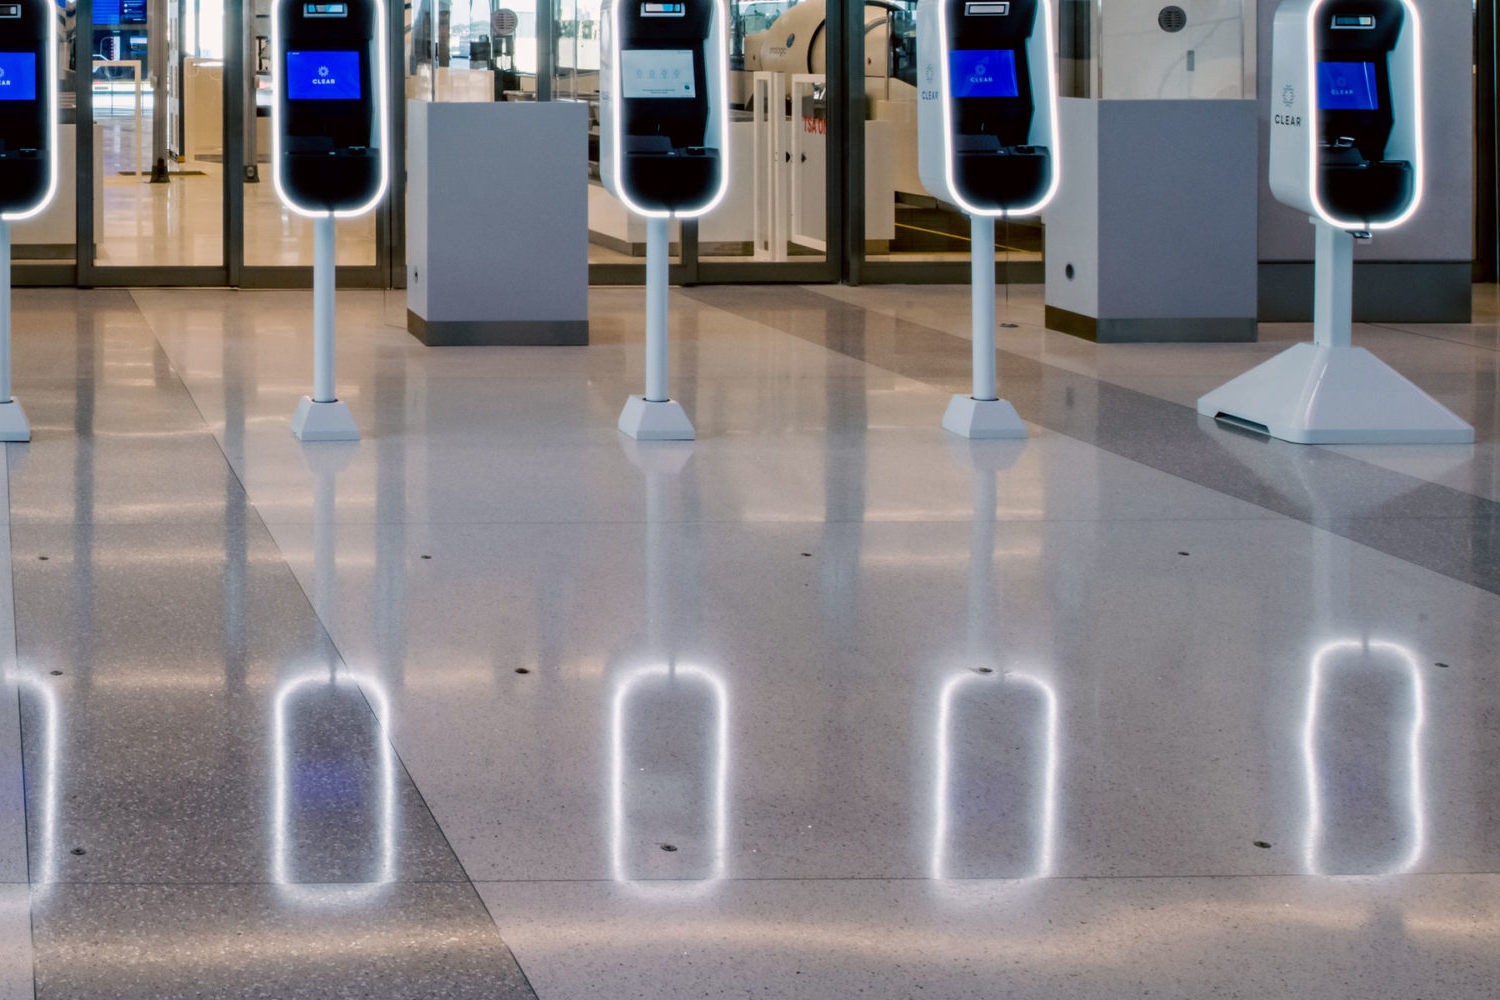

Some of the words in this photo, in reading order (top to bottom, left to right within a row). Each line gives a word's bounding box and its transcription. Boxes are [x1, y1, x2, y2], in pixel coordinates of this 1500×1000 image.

[921, 91, 939, 101] CLEAR
[803, 115, 817, 134] TSA
[1275, 114, 1302, 126] CLEAR
